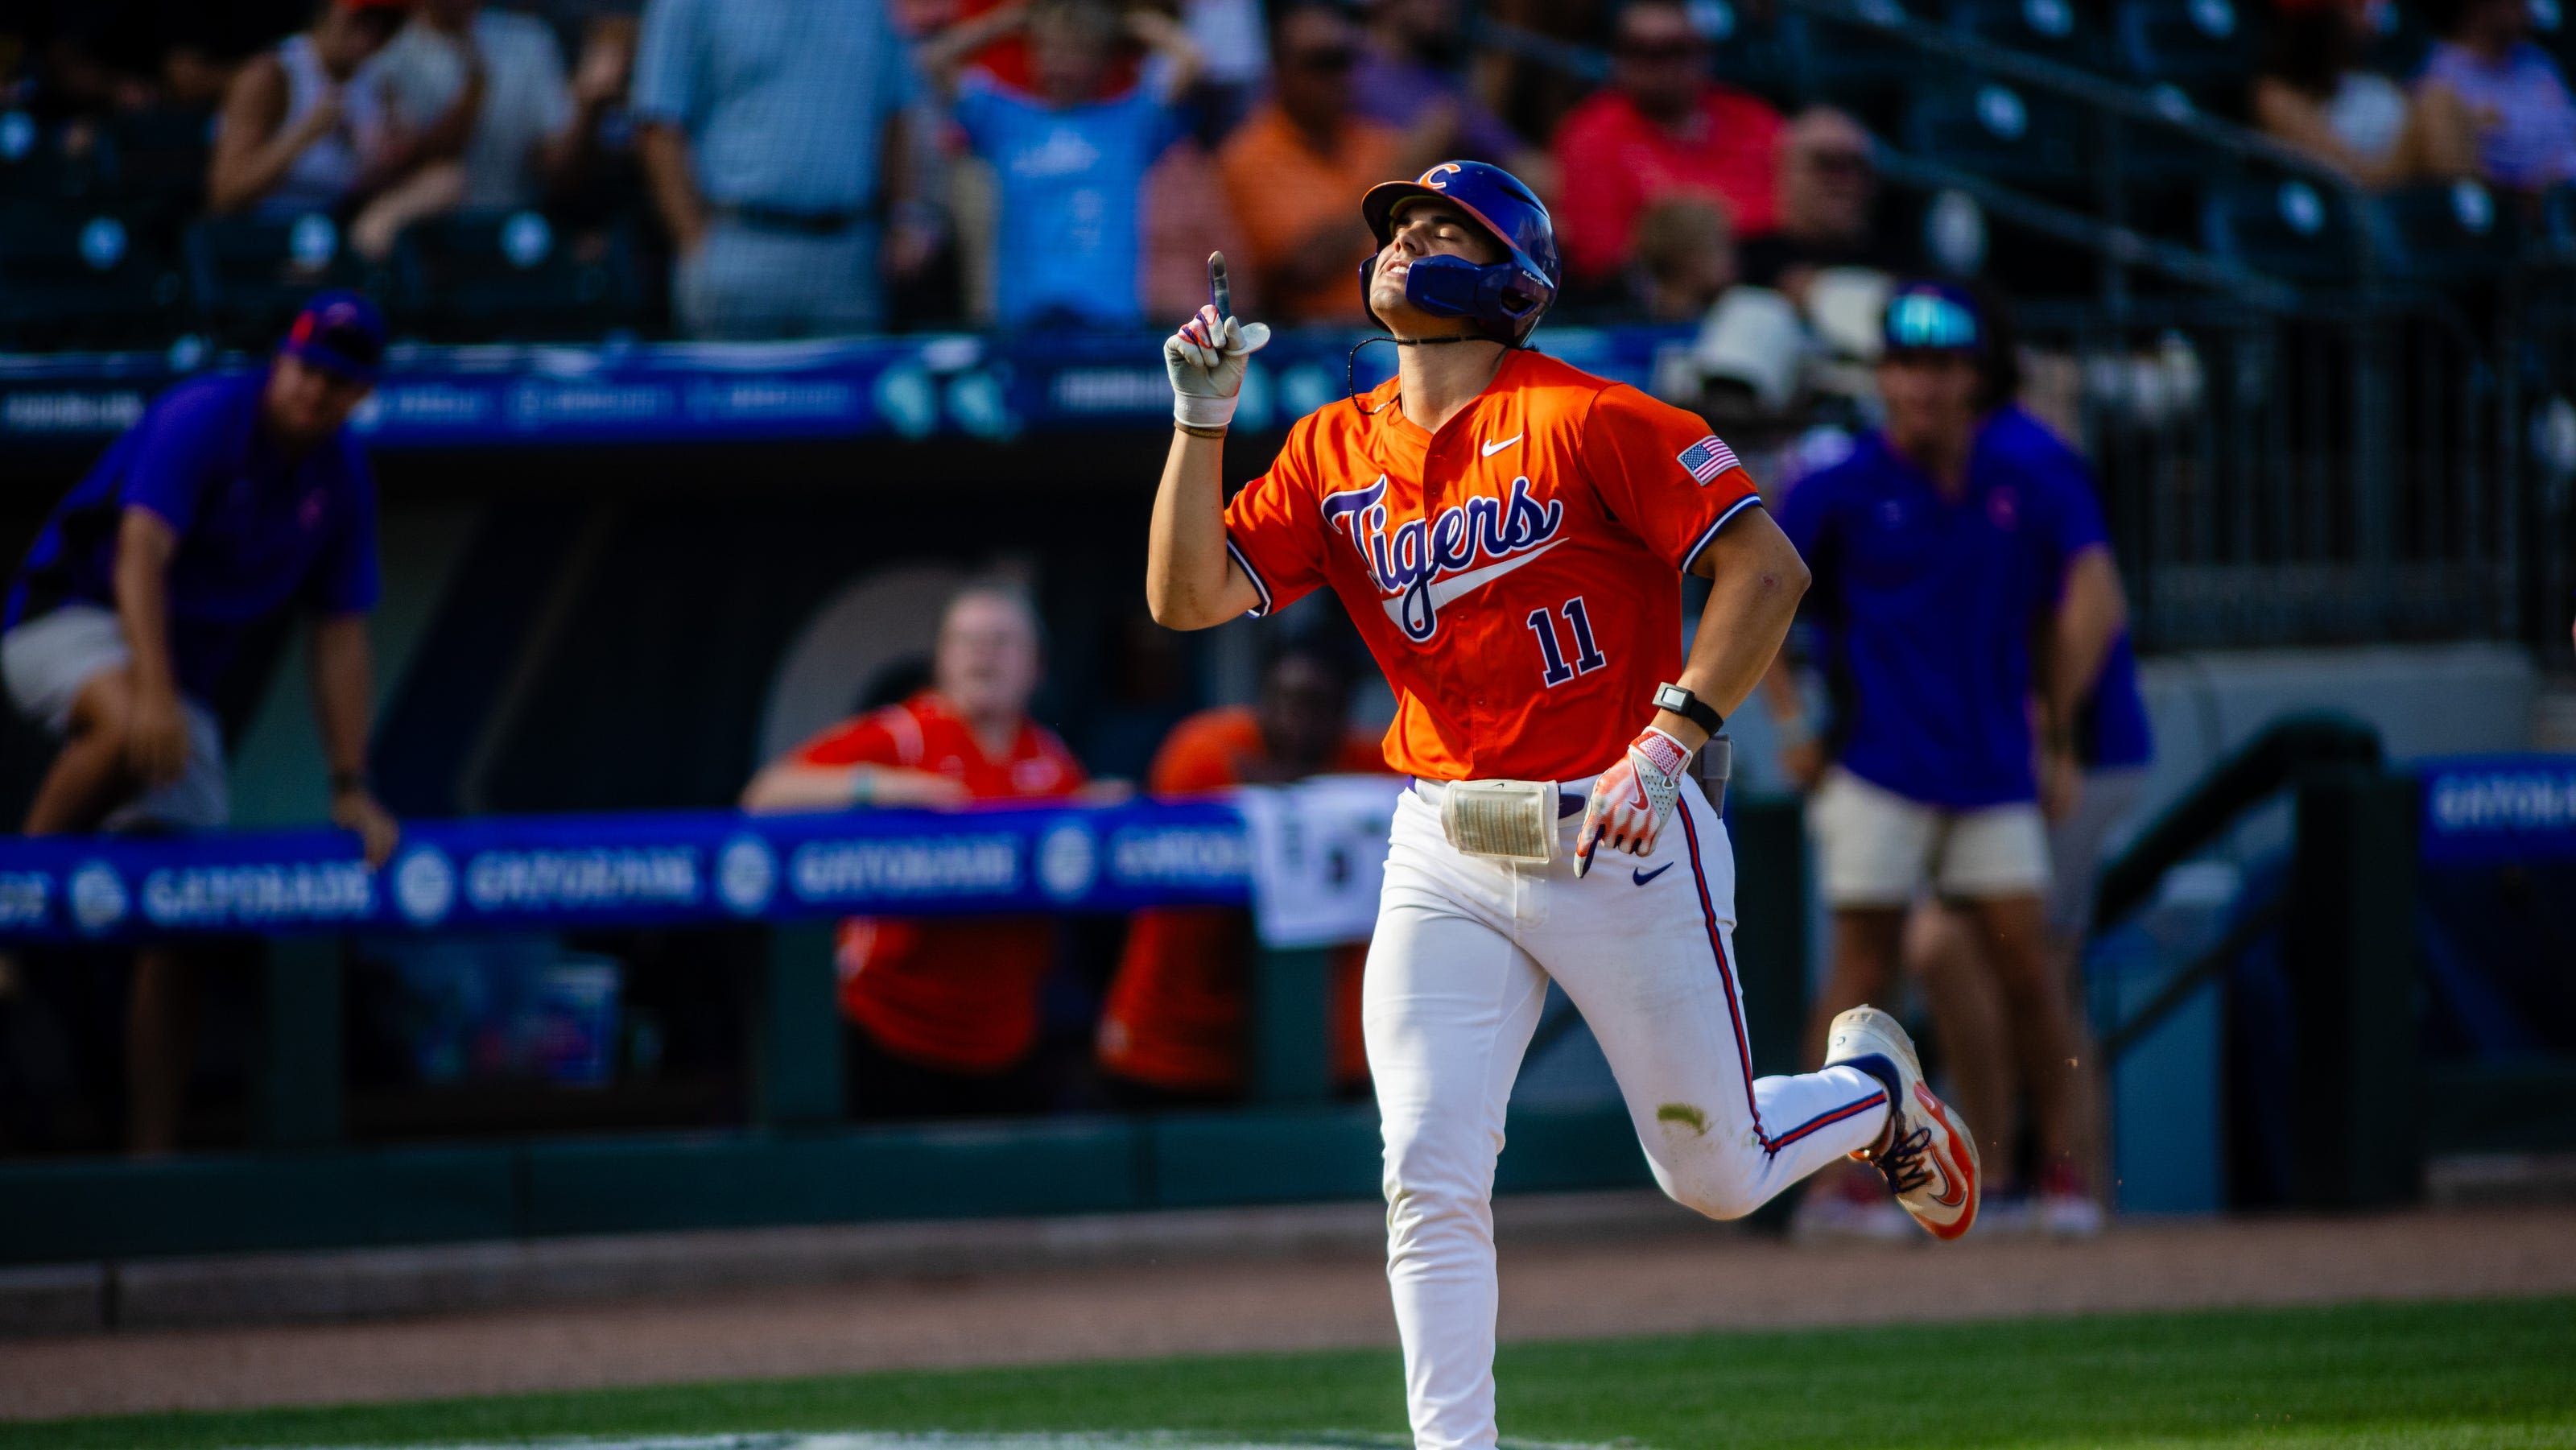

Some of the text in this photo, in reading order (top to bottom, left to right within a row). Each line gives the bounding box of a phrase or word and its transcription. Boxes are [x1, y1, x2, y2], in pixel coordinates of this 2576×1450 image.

[1418, 163, 1462, 190] C
[1321, 473, 1564, 642] Tigers
[1526, 595, 1607, 688] 11
[2431, 775, 2576, 827] GATOR
[467, 852, 699, 911] GATORADE
[795, 835, 1018, 897] GATORADE
